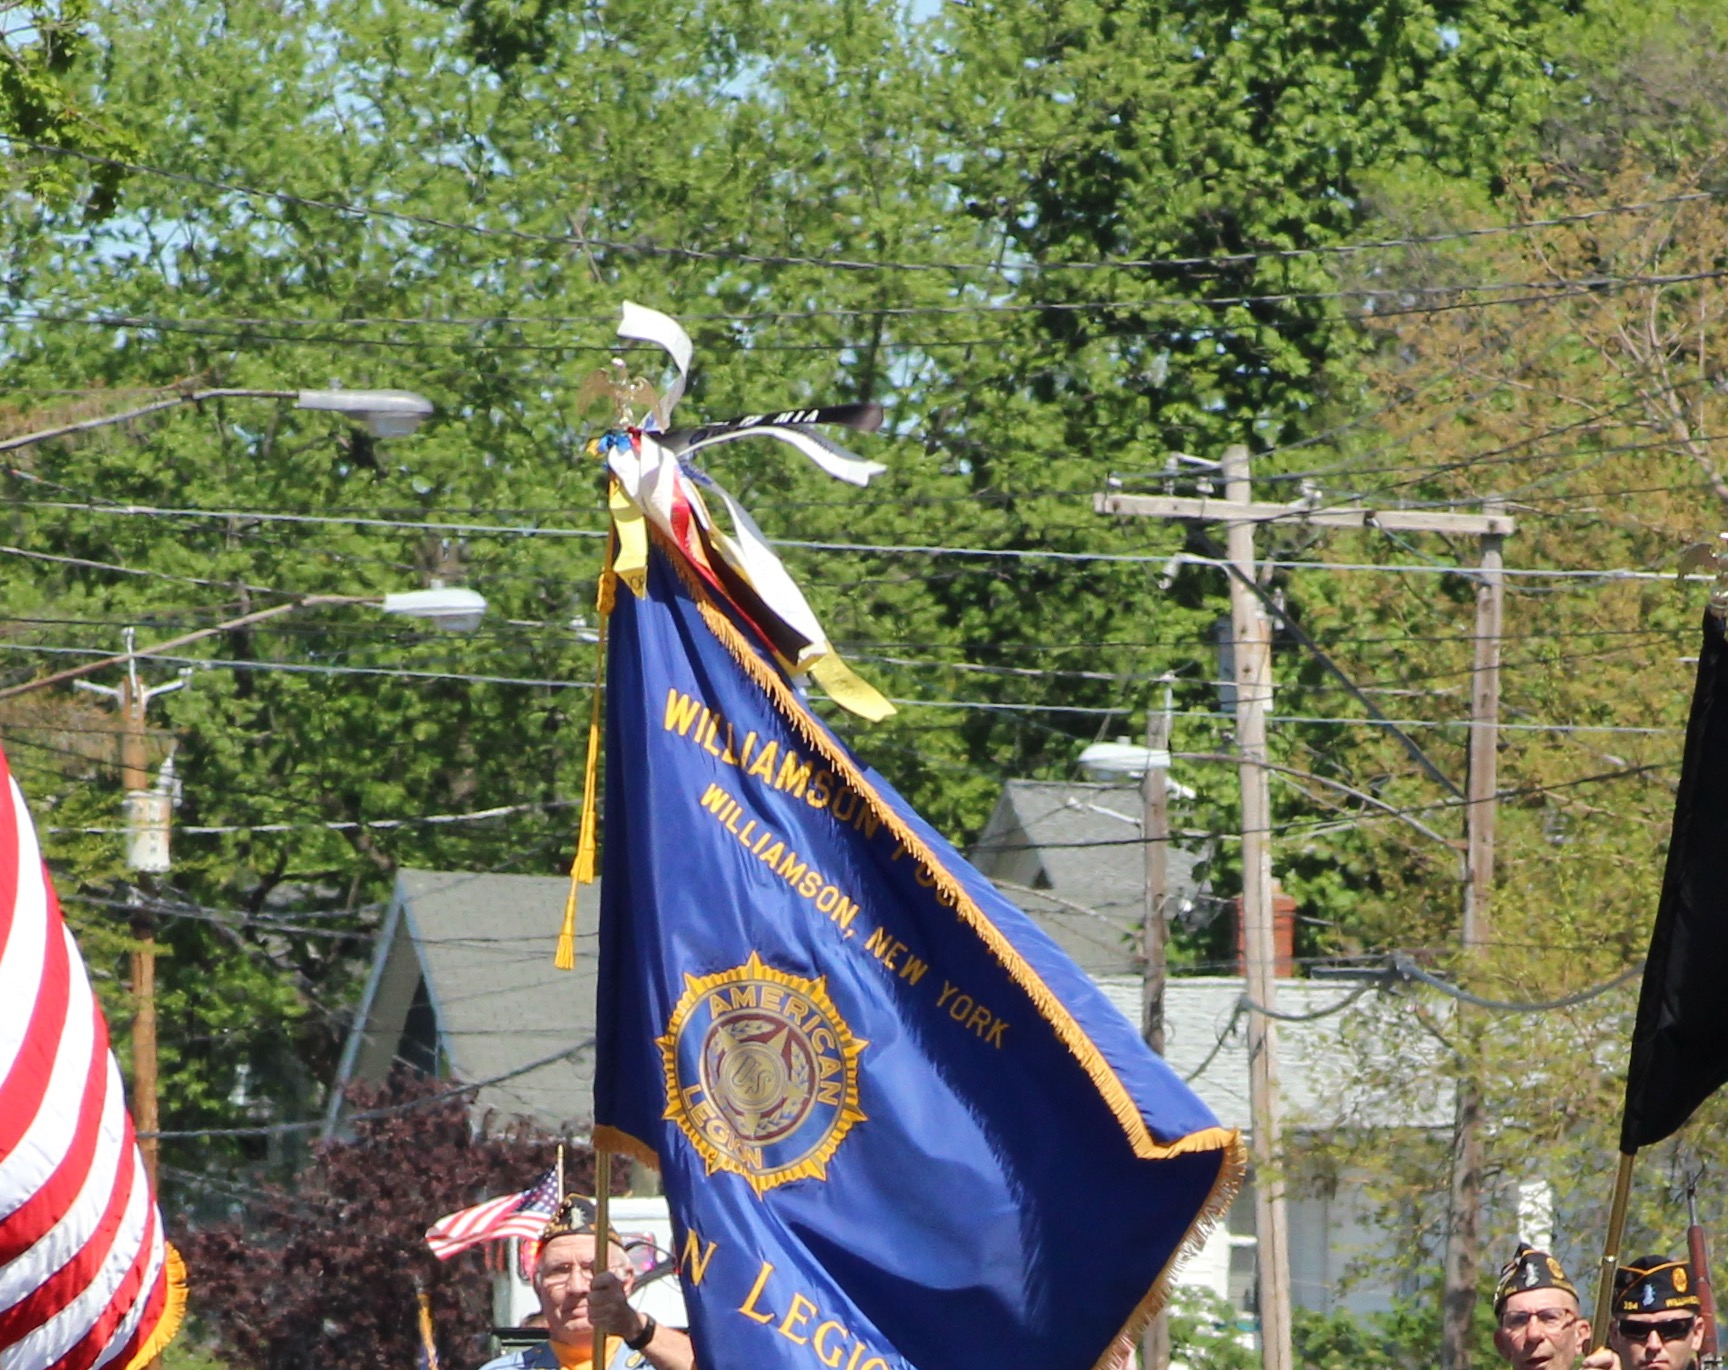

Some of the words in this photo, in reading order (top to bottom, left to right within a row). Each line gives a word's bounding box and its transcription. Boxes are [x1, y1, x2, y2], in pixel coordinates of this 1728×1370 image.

[663, 688, 880, 839] WILLIAMSON
[700, 783, 860, 939] WILLIAMSON,
[864, 926, 928, 986] NEW
[936, 980, 1010, 1048] YORK
[709, 986, 842, 1106] AMERICAN
[682, 1084, 762, 1169] LEGION
